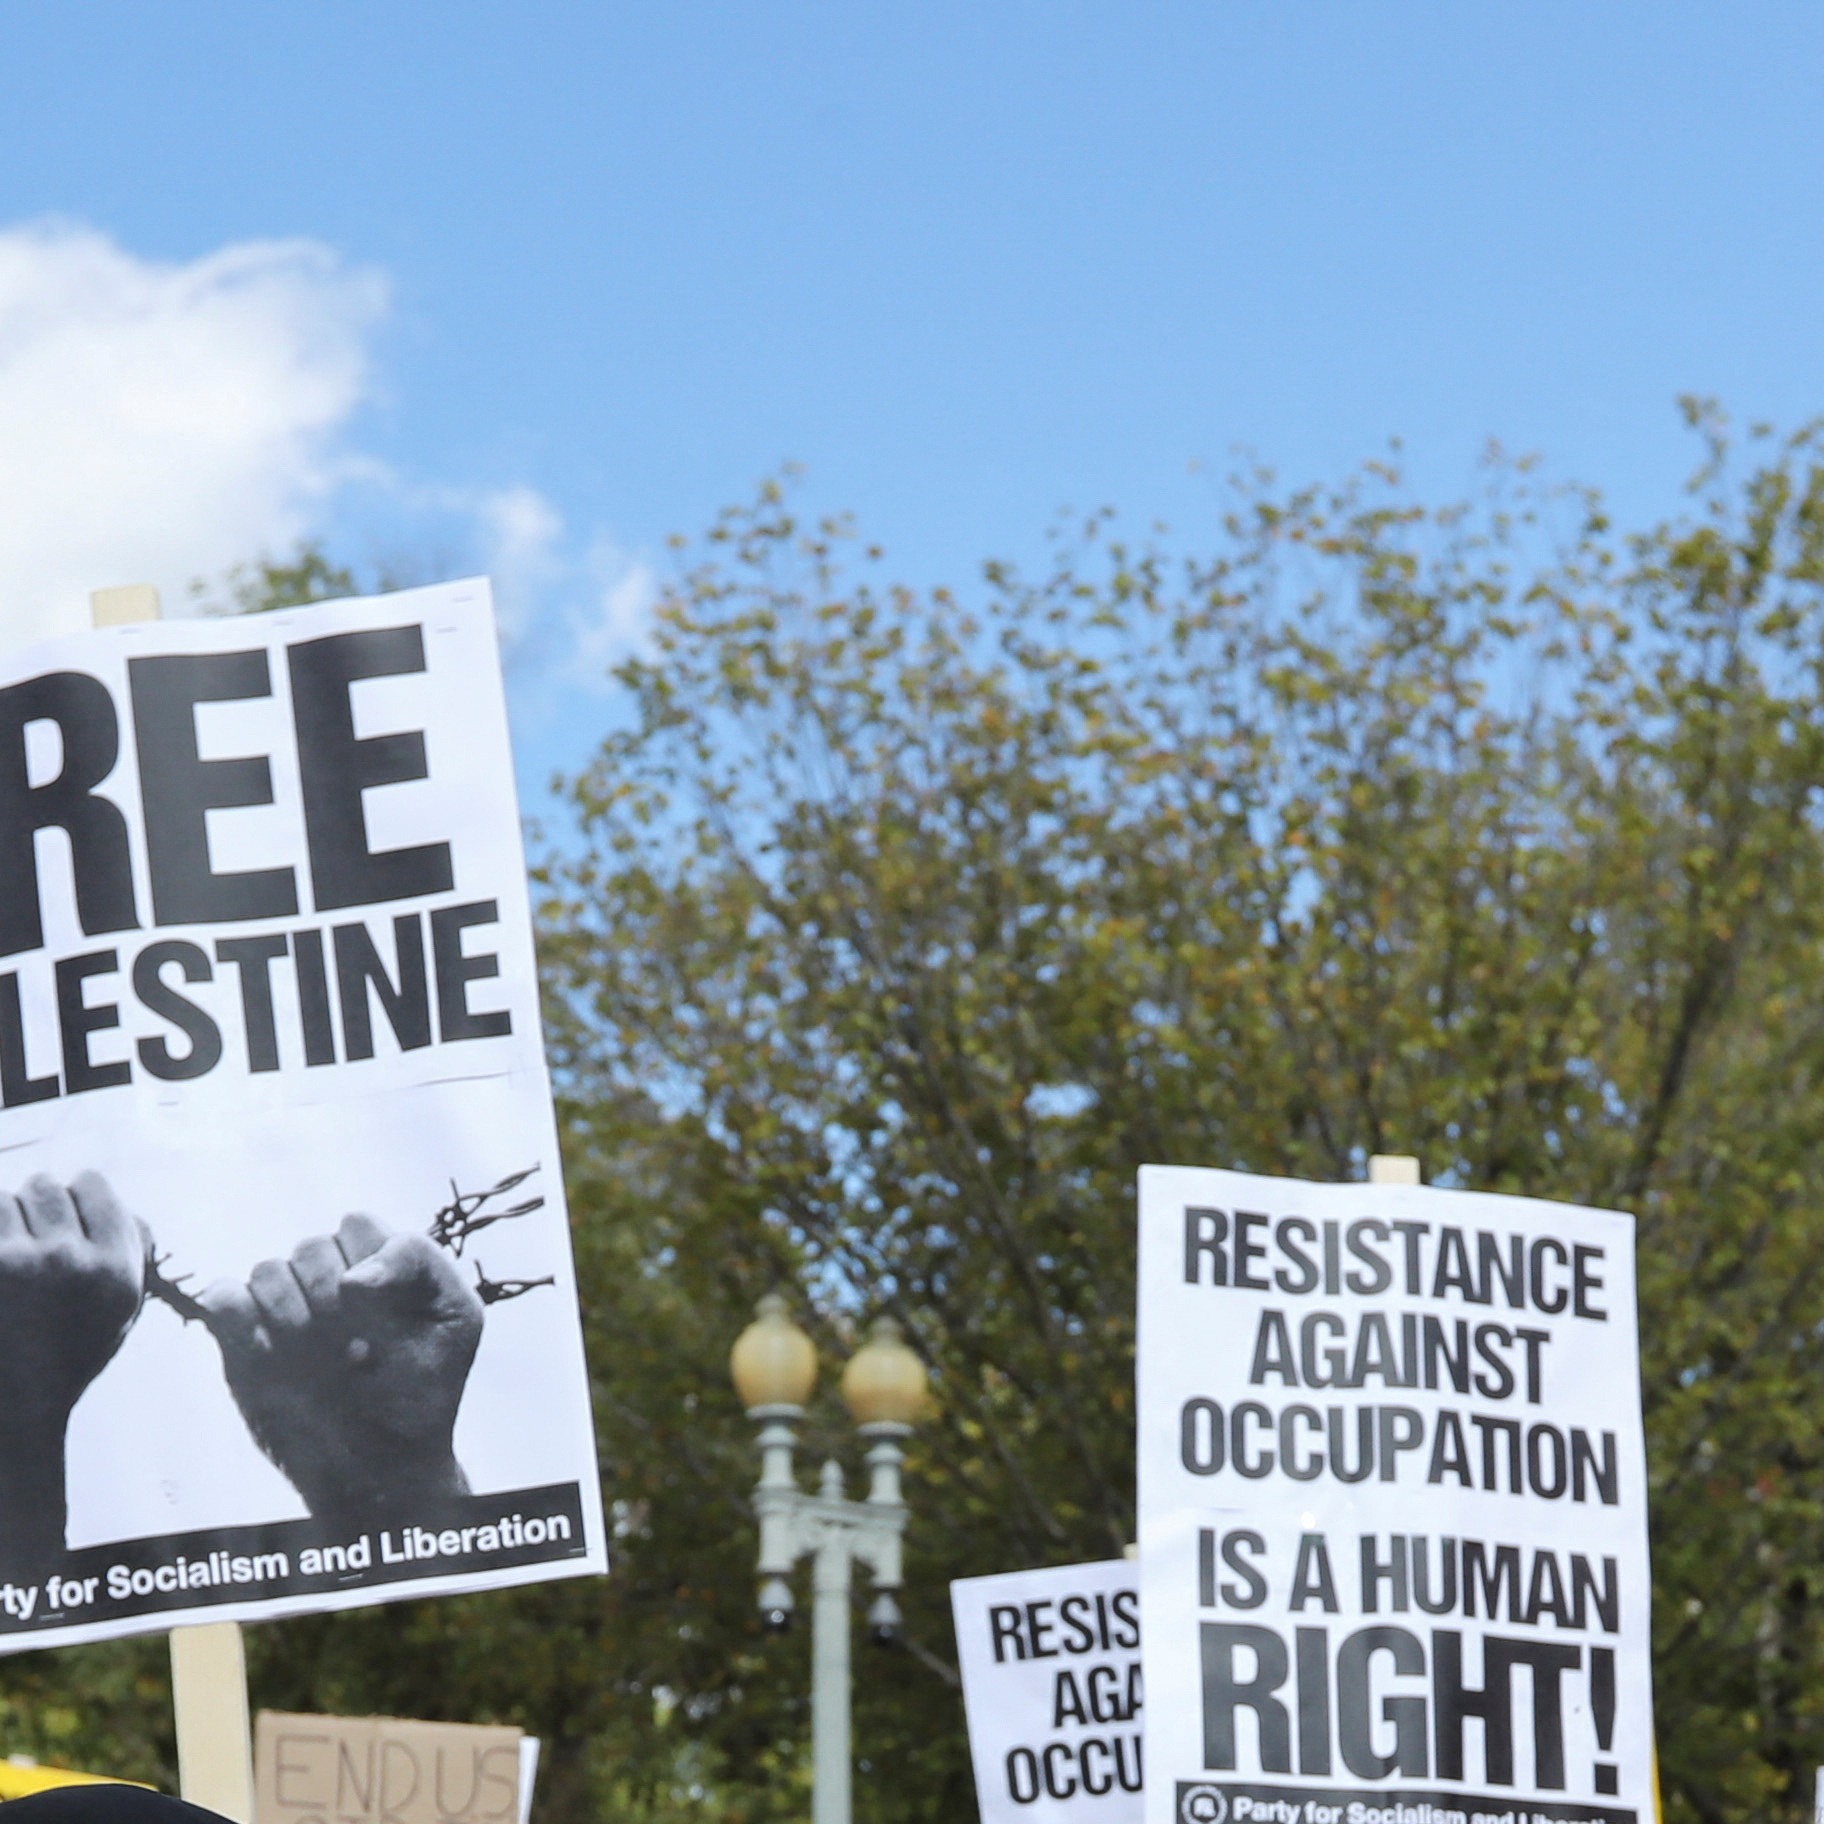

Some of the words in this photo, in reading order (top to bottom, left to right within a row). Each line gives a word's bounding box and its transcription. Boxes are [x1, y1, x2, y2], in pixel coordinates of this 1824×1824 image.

[1183, 1205, 1608, 1322] RESISTANCE
[1249, 1309, 1551, 1405] AGAINST
[1180, 1397, 1621, 1505] OCCUPATION
[46, 1573, 99, 1613] for
[107, 1547, 289, 1599] Socialism
[299, 1535, 371, 1577] and
[380, 1511, 571, 1565] Liberation
[1198, 1528, 1269, 1612] IS
[1288, 1533, 1341, 1614] A
[1361, 1534, 1621, 1635] HUMAN
[1198, 1621, 1621, 1797] RIGHT!
[276, 1734, 420, 1813] END
[435, 1745, 520, 1820] US
